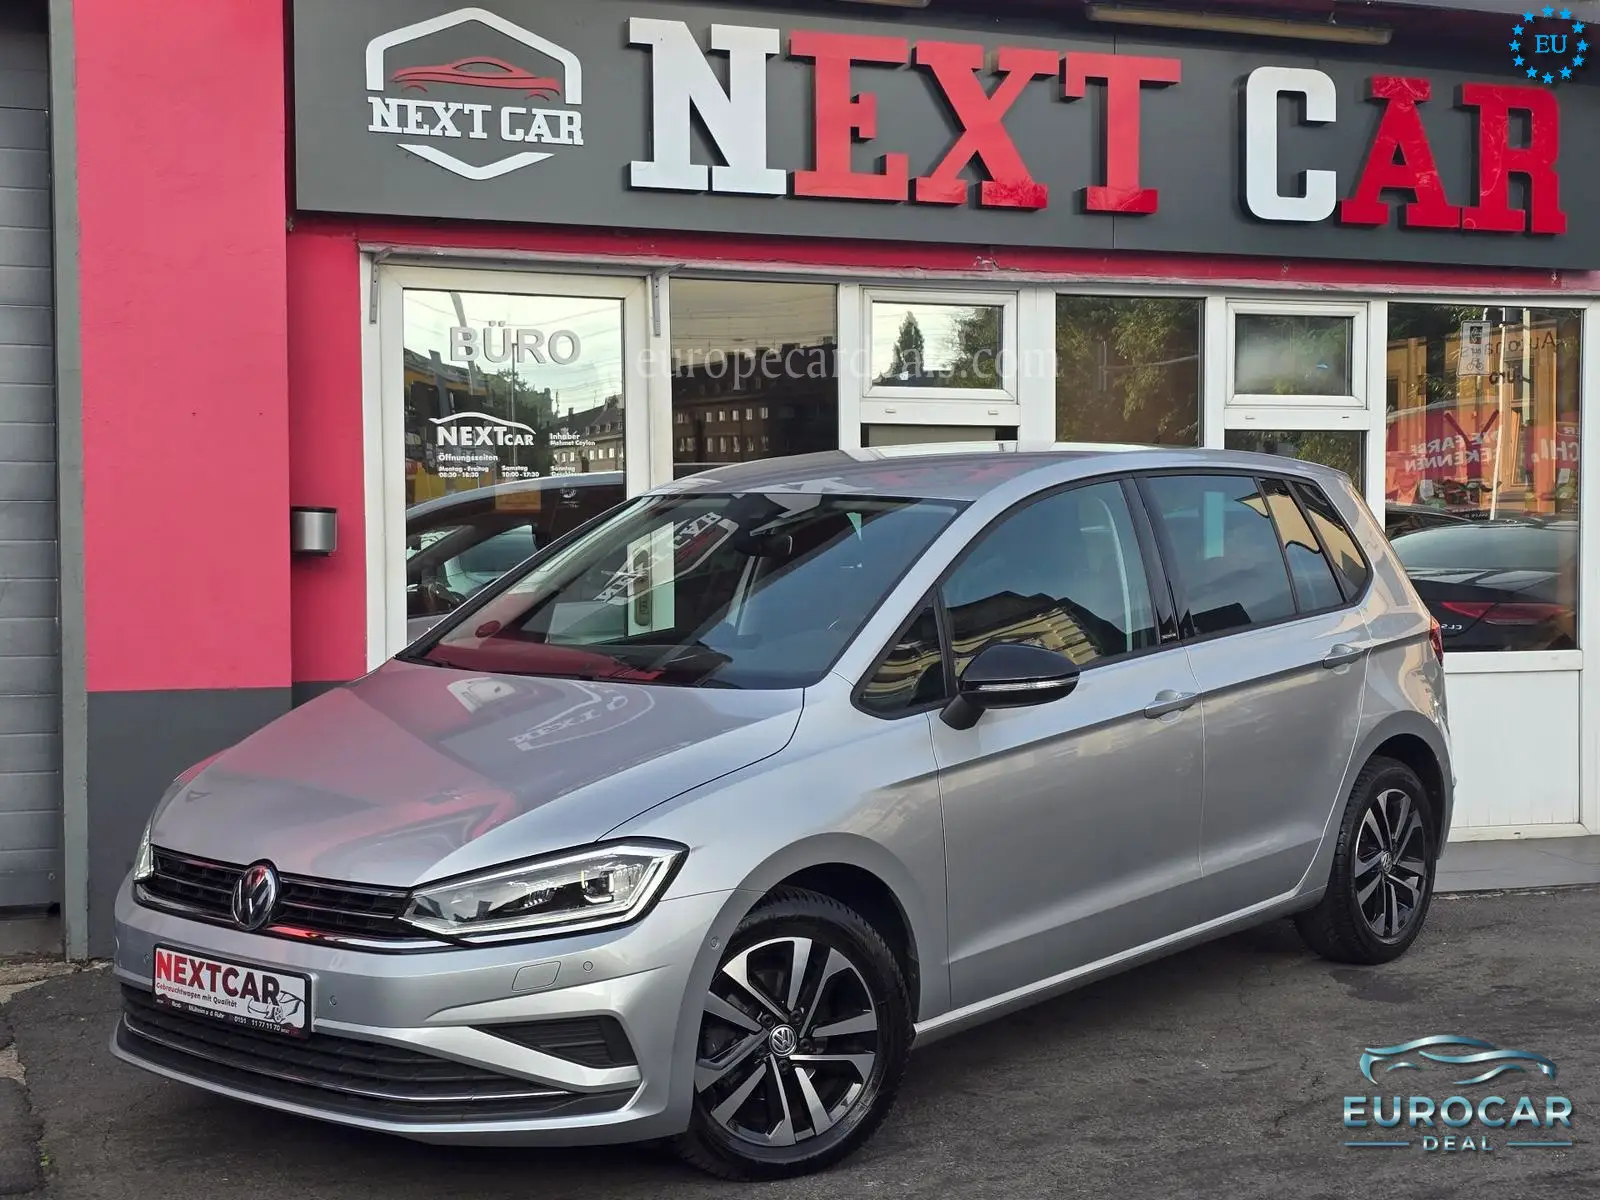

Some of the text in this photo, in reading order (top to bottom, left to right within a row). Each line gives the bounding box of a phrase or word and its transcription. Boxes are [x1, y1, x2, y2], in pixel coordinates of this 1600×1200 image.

[367, 96, 584, 146] NEXT CAR
[628, 17, 1567, 235] NEXT CAR
[449, 320, 582, 365] BÜRO
[438, 453, 499, 463] Öffnungszeiten
[155, 950, 282, 1007] NEXTCAR
[155, 982, 238, 1009] Gebrauchtwagen mit Qualität
